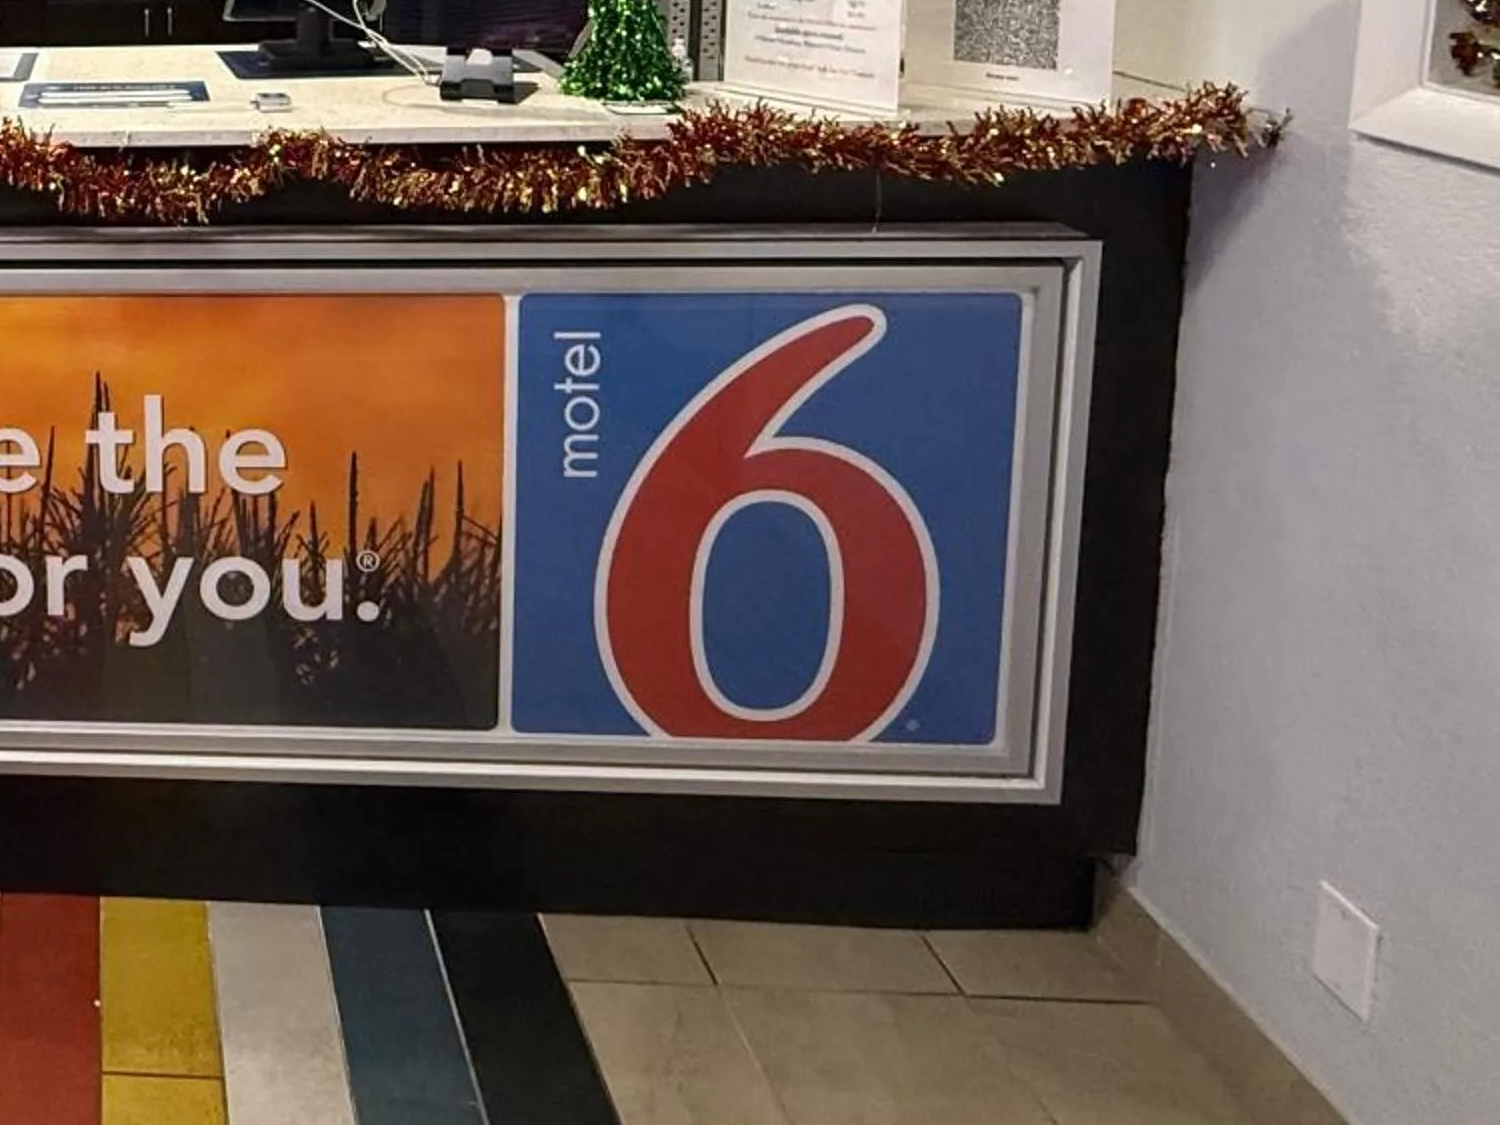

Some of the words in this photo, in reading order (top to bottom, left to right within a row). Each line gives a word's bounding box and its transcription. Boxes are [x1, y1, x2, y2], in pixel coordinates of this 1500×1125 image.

[85, 394, 288, 495] the
[553, 331, 602, 478] motel
[593, 303, 941, 743] 6
